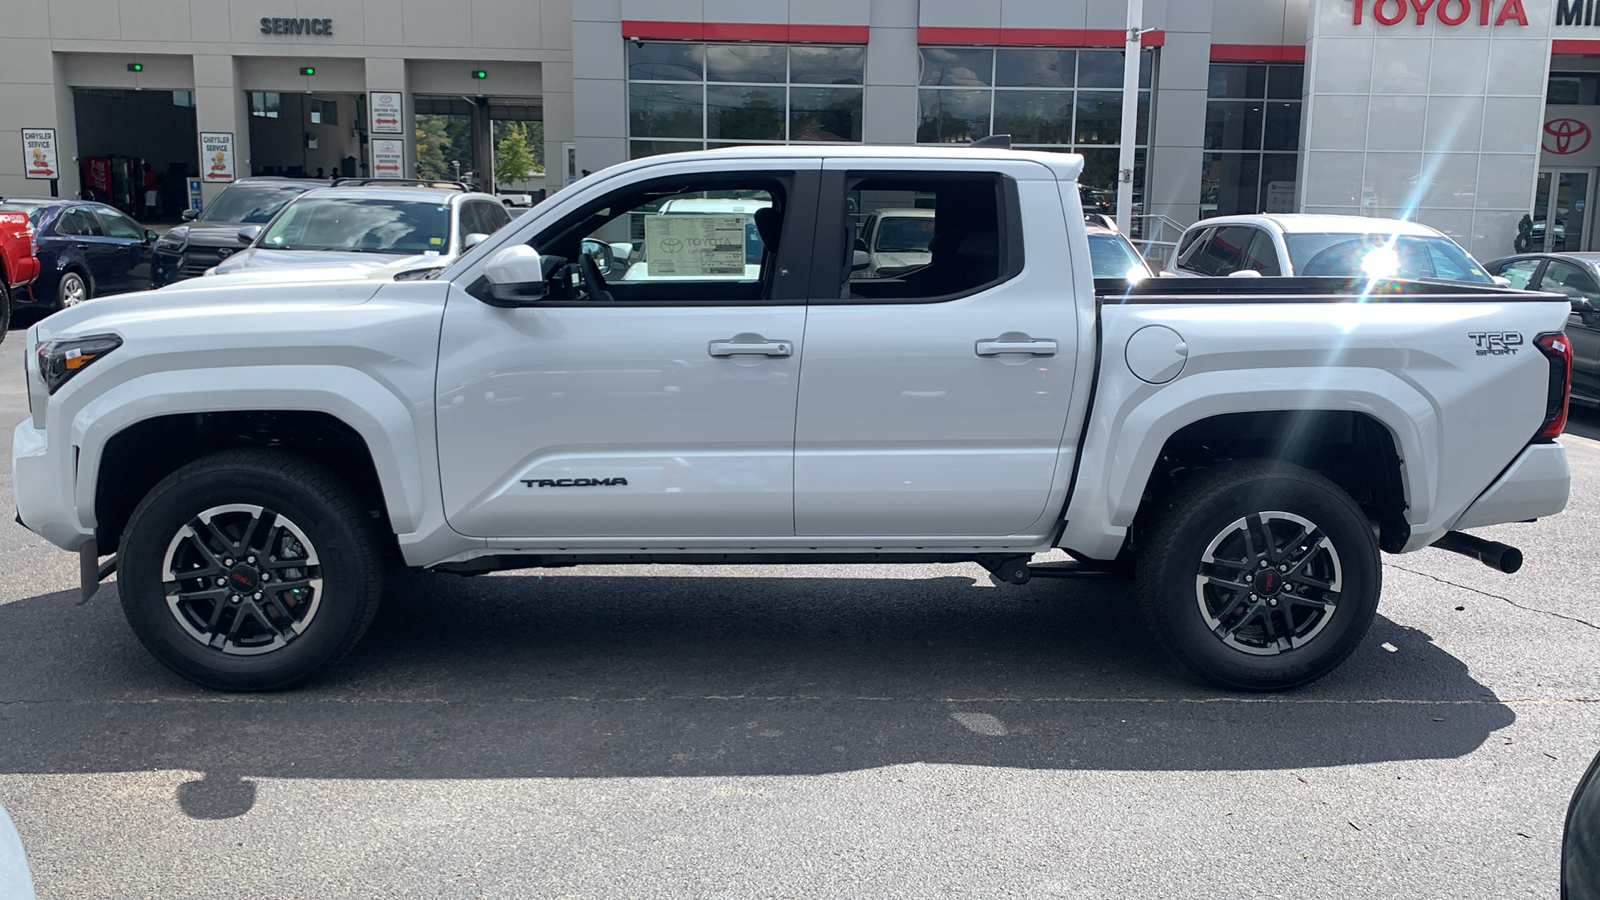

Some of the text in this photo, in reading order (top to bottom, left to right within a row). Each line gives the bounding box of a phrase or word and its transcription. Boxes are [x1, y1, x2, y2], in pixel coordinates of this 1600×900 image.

[1350, 0, 1530, 26] TOYOTA
[1555, 0, 1600, 26] MI
[260, 17, 333, 35] SERVICE
[25, 132, 52, 140] CHRYSLER
[687, 237, 731, 246] TOYOTA
[1468, 331, 1523, 350] TRD
[1475, 348, 1519, 356] SPORT
[520, 477, 628, 488] TACOMA
